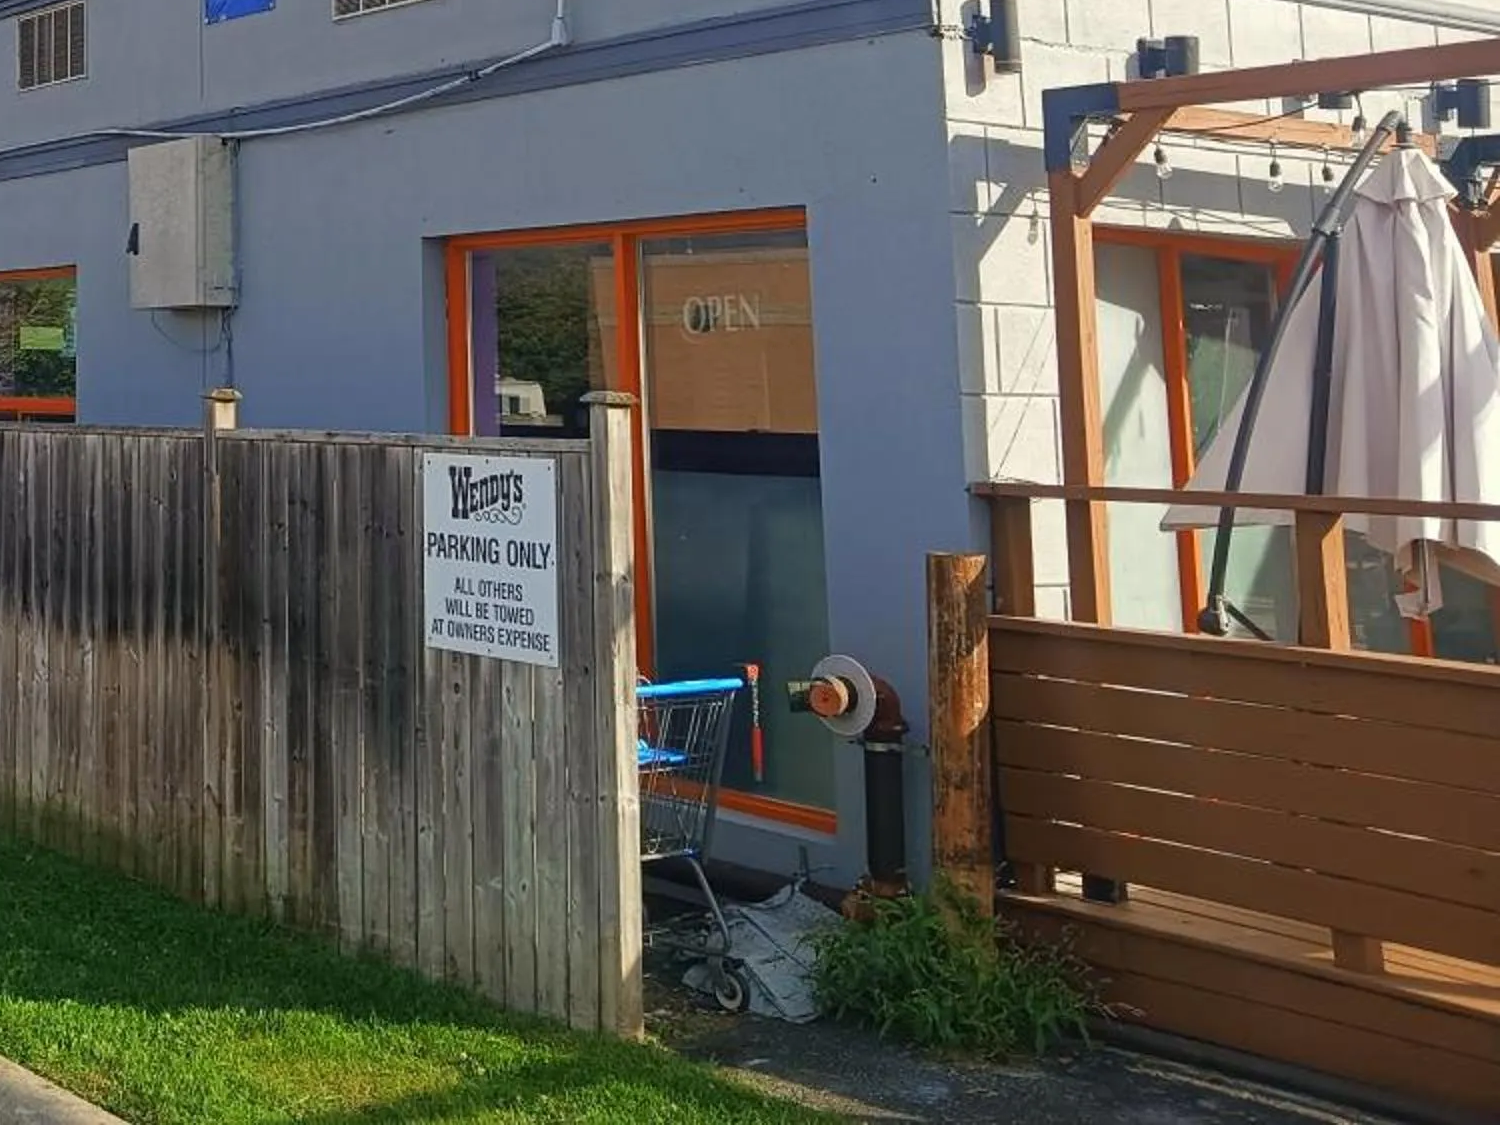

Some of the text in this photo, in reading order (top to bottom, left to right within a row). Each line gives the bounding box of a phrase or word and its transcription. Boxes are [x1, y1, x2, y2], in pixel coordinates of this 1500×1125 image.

[683, 294, 761, 334] OPEN
[427, 532, 551, 570] PARKING ONLY
[454, 577, 523, 601] ALL OTHERS
[445, 597, 535, 626] WILL BE TOWED
[431, 618, 550, 652] AT OWNERS EXPENSE
